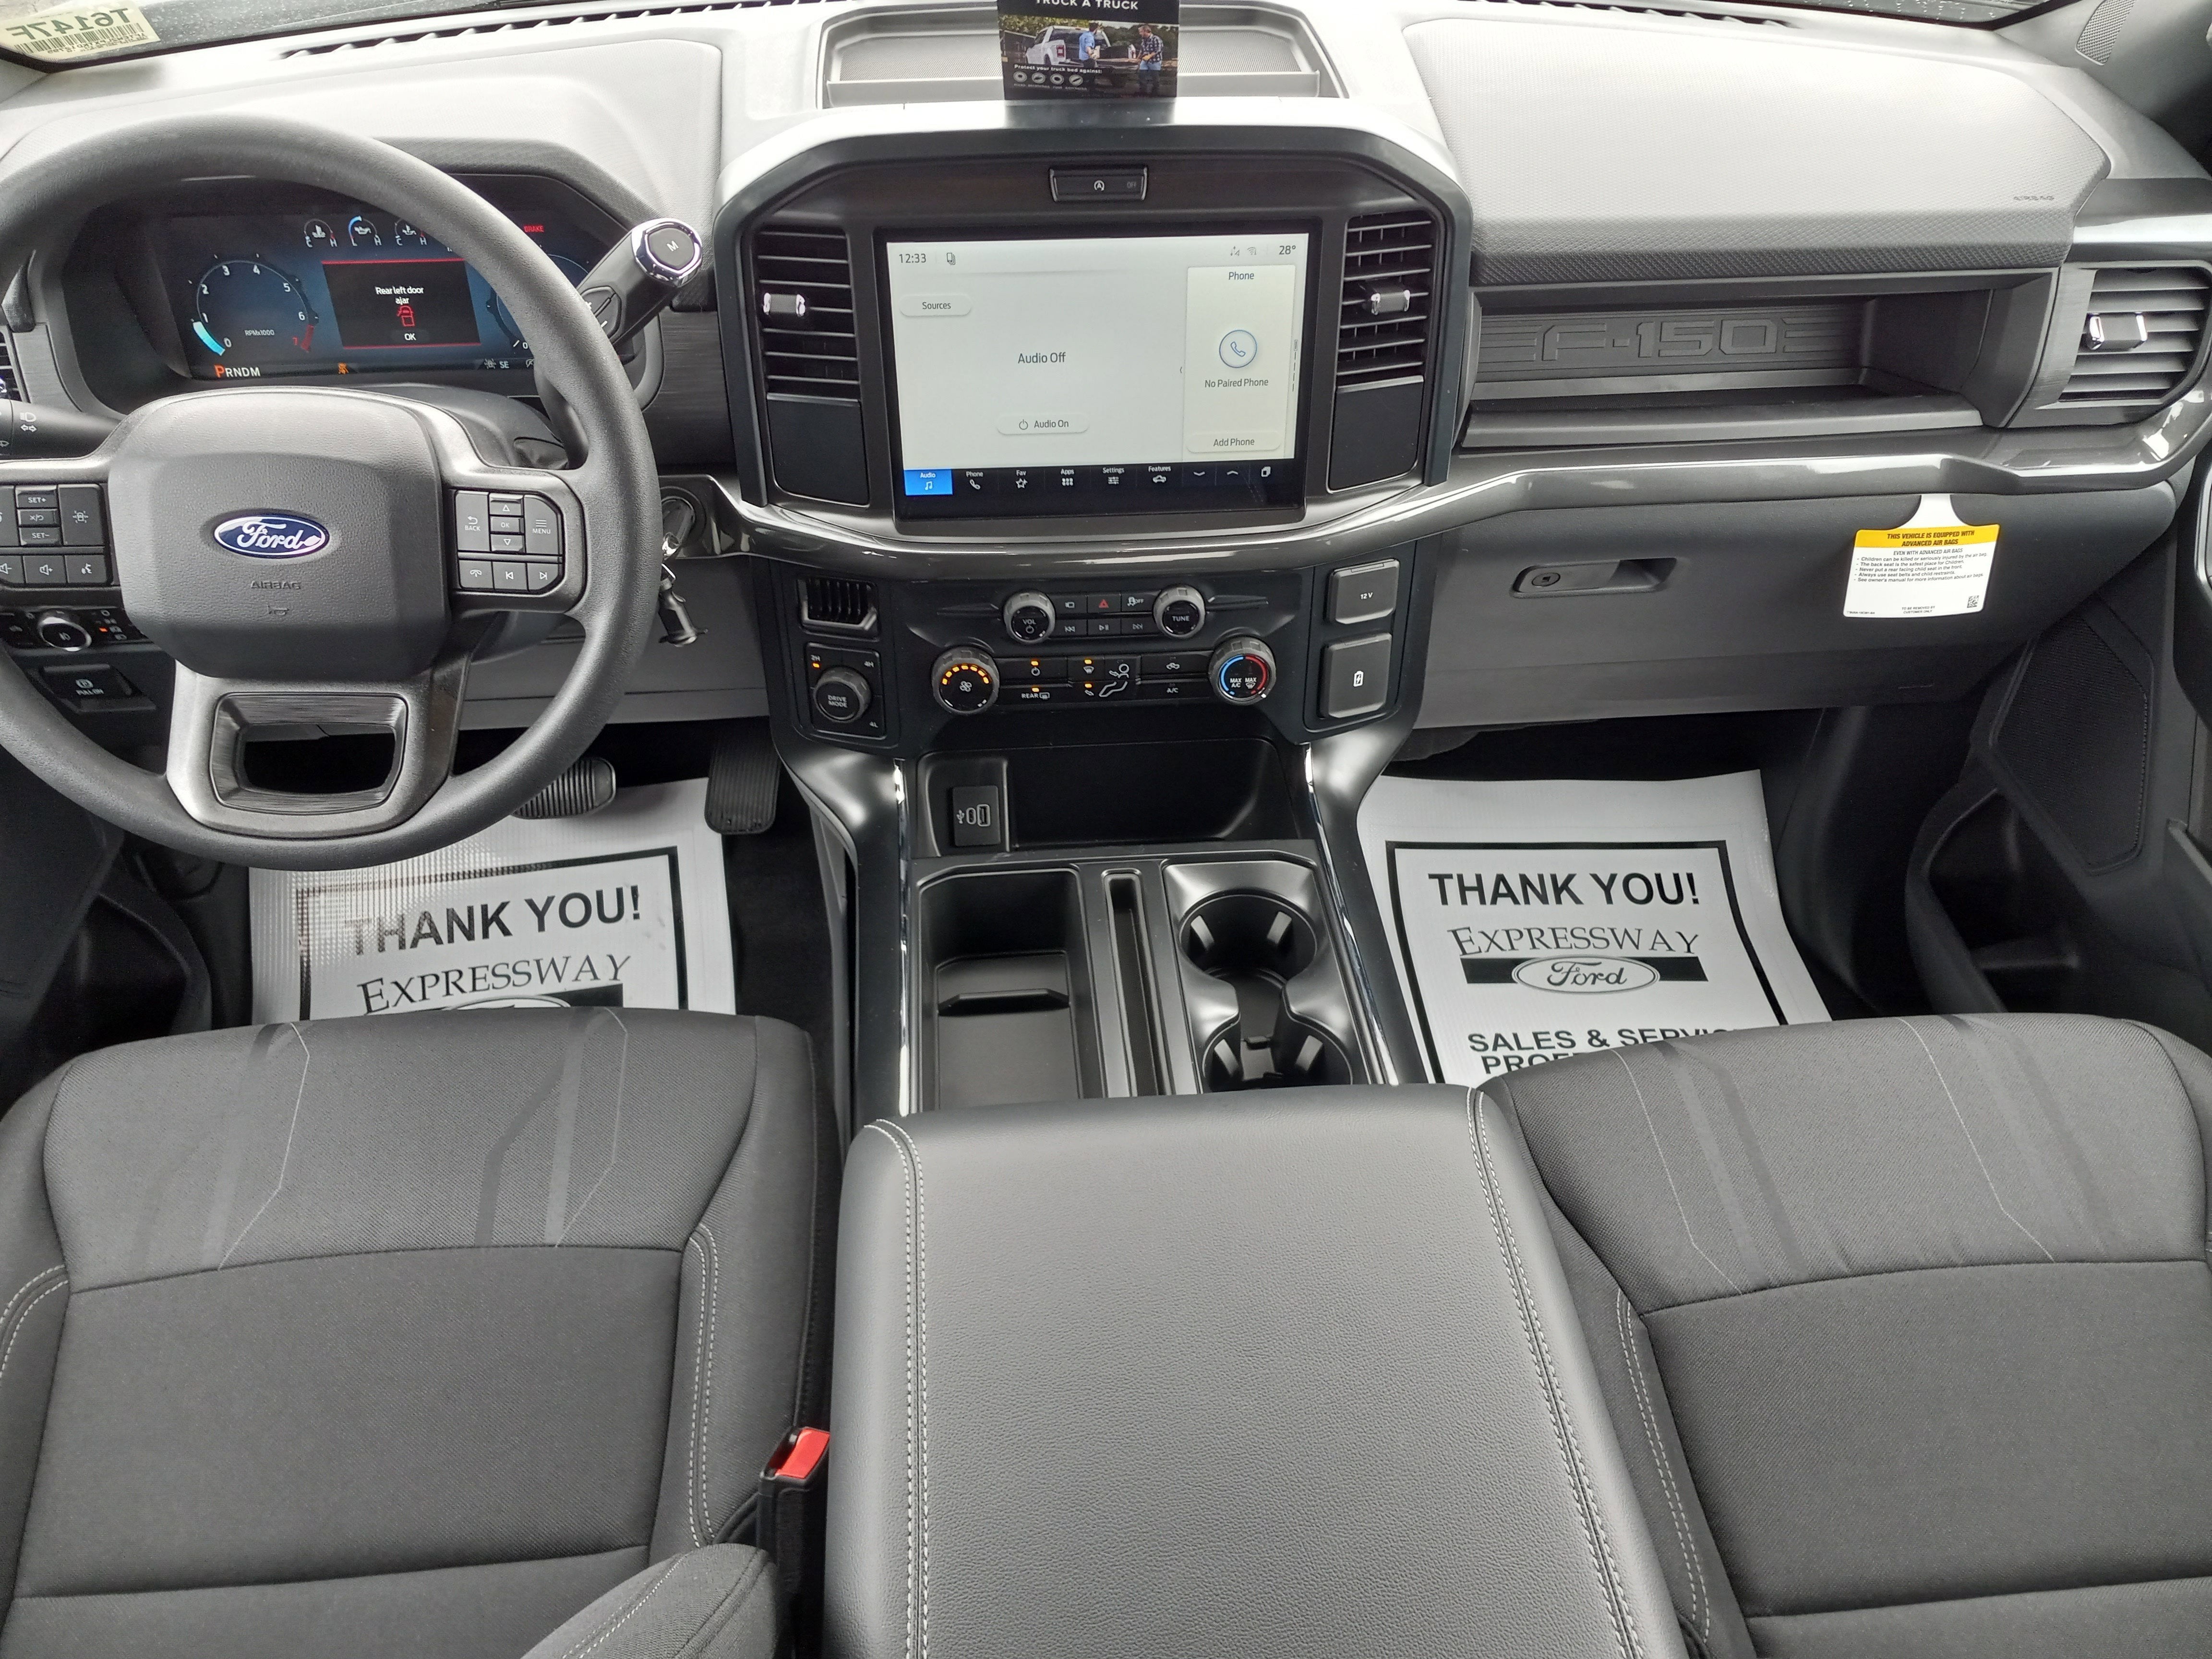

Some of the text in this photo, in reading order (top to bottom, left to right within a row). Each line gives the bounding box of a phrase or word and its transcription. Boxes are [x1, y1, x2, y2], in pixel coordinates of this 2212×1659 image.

[1095, 0, 1138, 10] TRUCK
[666, 240, 679, 252] M
[1279, 245, 1296, 255] 28°
[899, 253, 927, 264] 12:33
[222, 265, 230, 276] 3
[253, 264, 261, 275] 4
[1228, 271, 1255, 280] Phone
[201, 284, 209, 295] 2
[283, 283, 290, 292] 5
[375, 287, 393, 295] Rear
[393, 286, 407, 294] left
[396, 296, 409, 305] ajar
[922, 301, 951, 310] Sources
[202, 313, 209, 323] 1
[298, 311, 305, 321] 6
[224, 337, 232, 348] 0
[1541, 317, 1778, 362] F-150
[1018, 352, 1066, 364] Audio Off
[1205, 378, 1269, 388] No Paired Phone
[1034, 420, 1069, 428] Audio On
[1213, 437, 1255, 447] Add Phone
[237, 521, 306, 550] Ford
[250, 580, 301, 590] AIRBAG
[1428, 872, 1700, 906] THANK YOU!
[345, 884, 640, 956] THANK YOU!
[1446, 926, 1699, 957] EXPRESSWAY
[1547, 961, 1627, 987] Ford
[357, 954, 632, 1015] EXPRESSWAY
[1467, 1030, 1576, 1052] SALES
[1587, 1029, 1611, 1047] &
